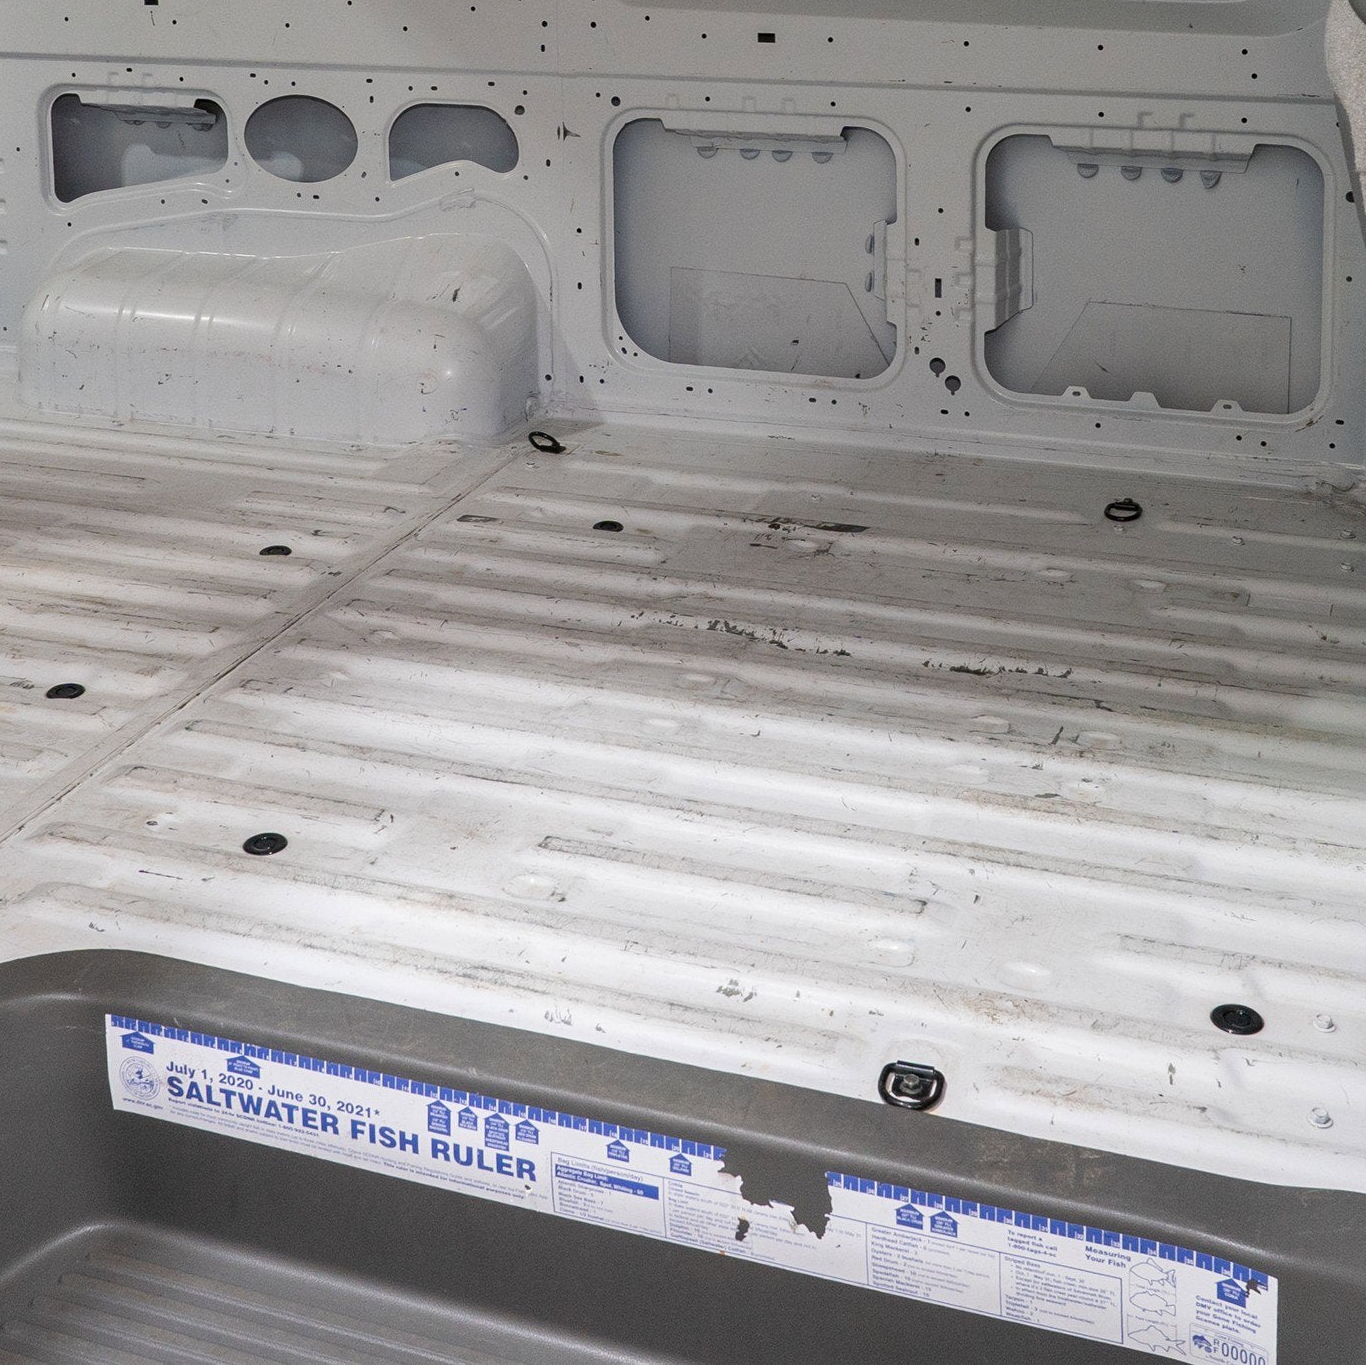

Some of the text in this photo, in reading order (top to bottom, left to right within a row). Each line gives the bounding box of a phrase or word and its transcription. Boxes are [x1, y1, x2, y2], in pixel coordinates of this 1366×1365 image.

[166, 1061, 195, 1079] July
[201, 1069, 213, 1083] 1,
[219, 1073, 253, 1091] 2020
[268, 1085, 303, 1102] June
[309, 1094, 331, 1111] 30,
[167, 1076, 339, 1135] SALTWATER
[351, 1119, 419, 1154] FISH
[431, 1138, 536, 1182] RULER
[1085, 1245, 1132, 1263] Measuring
[1085, 1254, 1126, 1269] Your Fish
